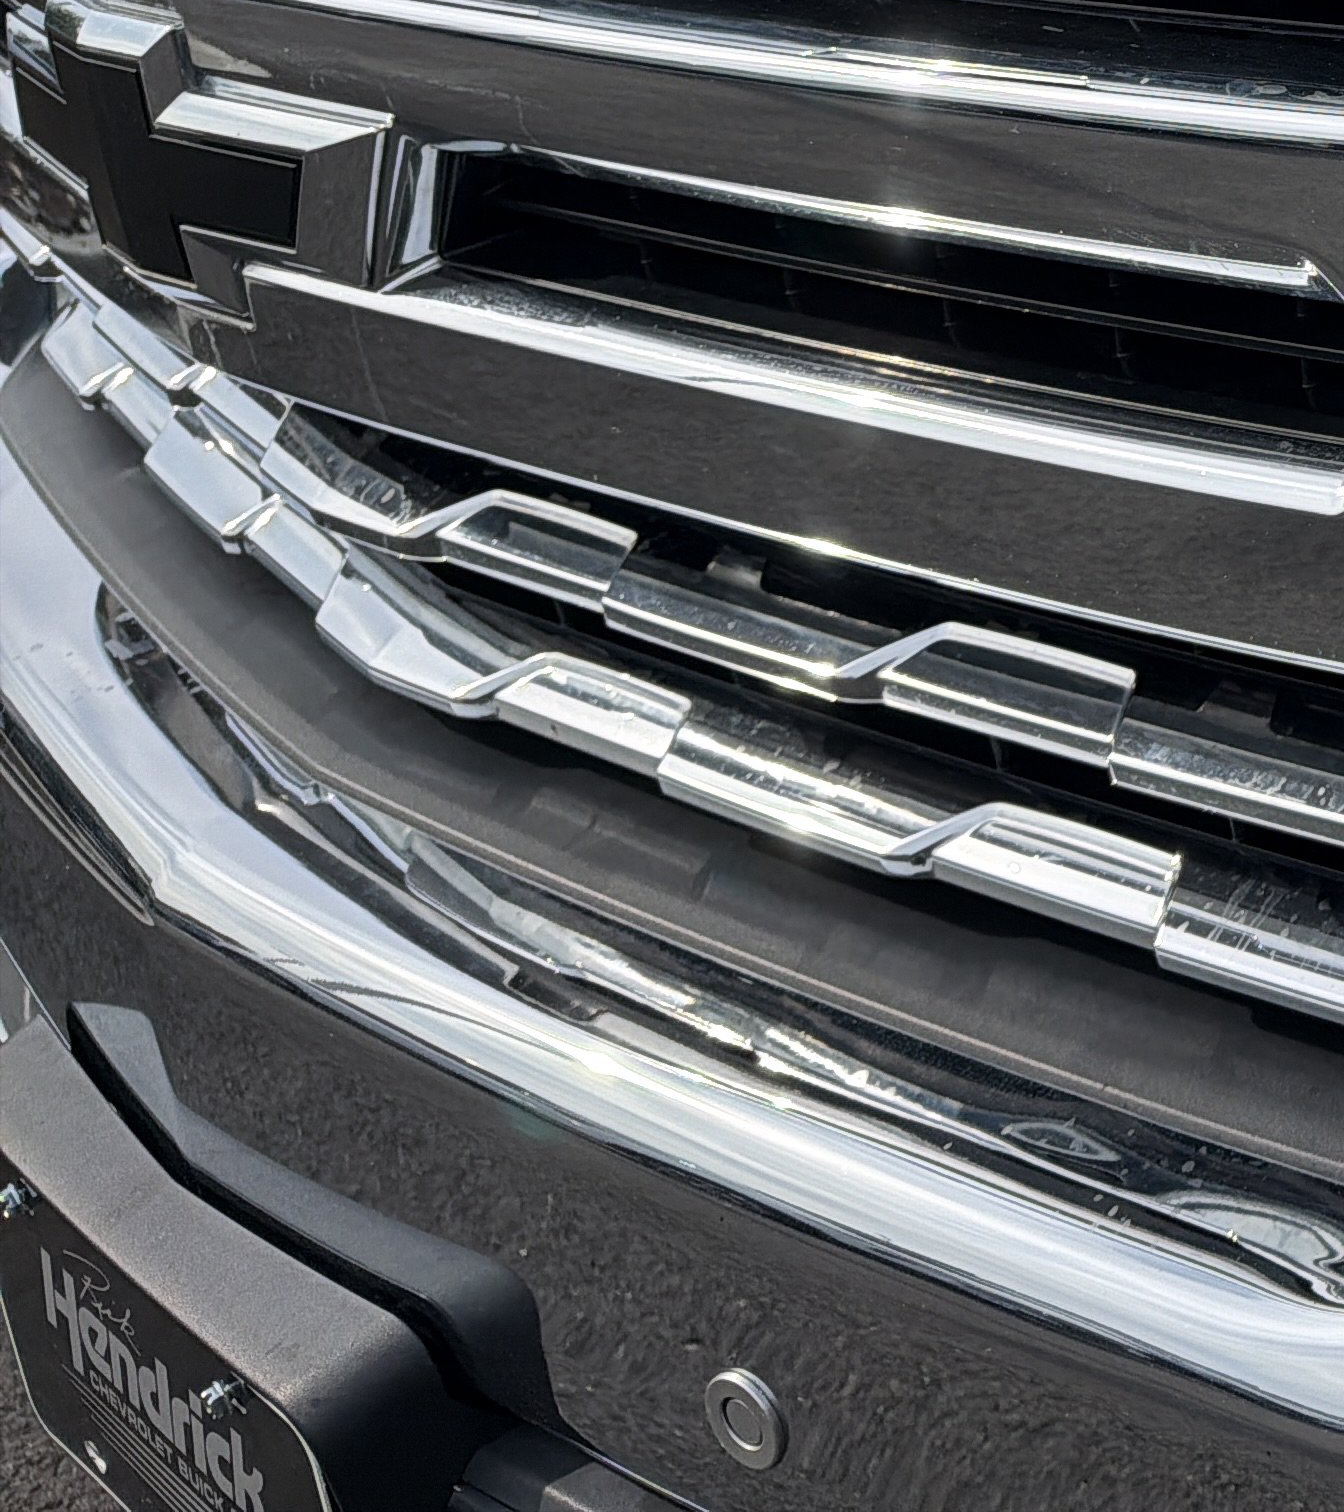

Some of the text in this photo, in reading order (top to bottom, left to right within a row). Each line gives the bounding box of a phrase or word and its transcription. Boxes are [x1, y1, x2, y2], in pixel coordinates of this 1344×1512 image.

[40, 1246, 265, 1512] Hendrick
[88, 1369, 225, 1512] CHEVROLET BUICK
